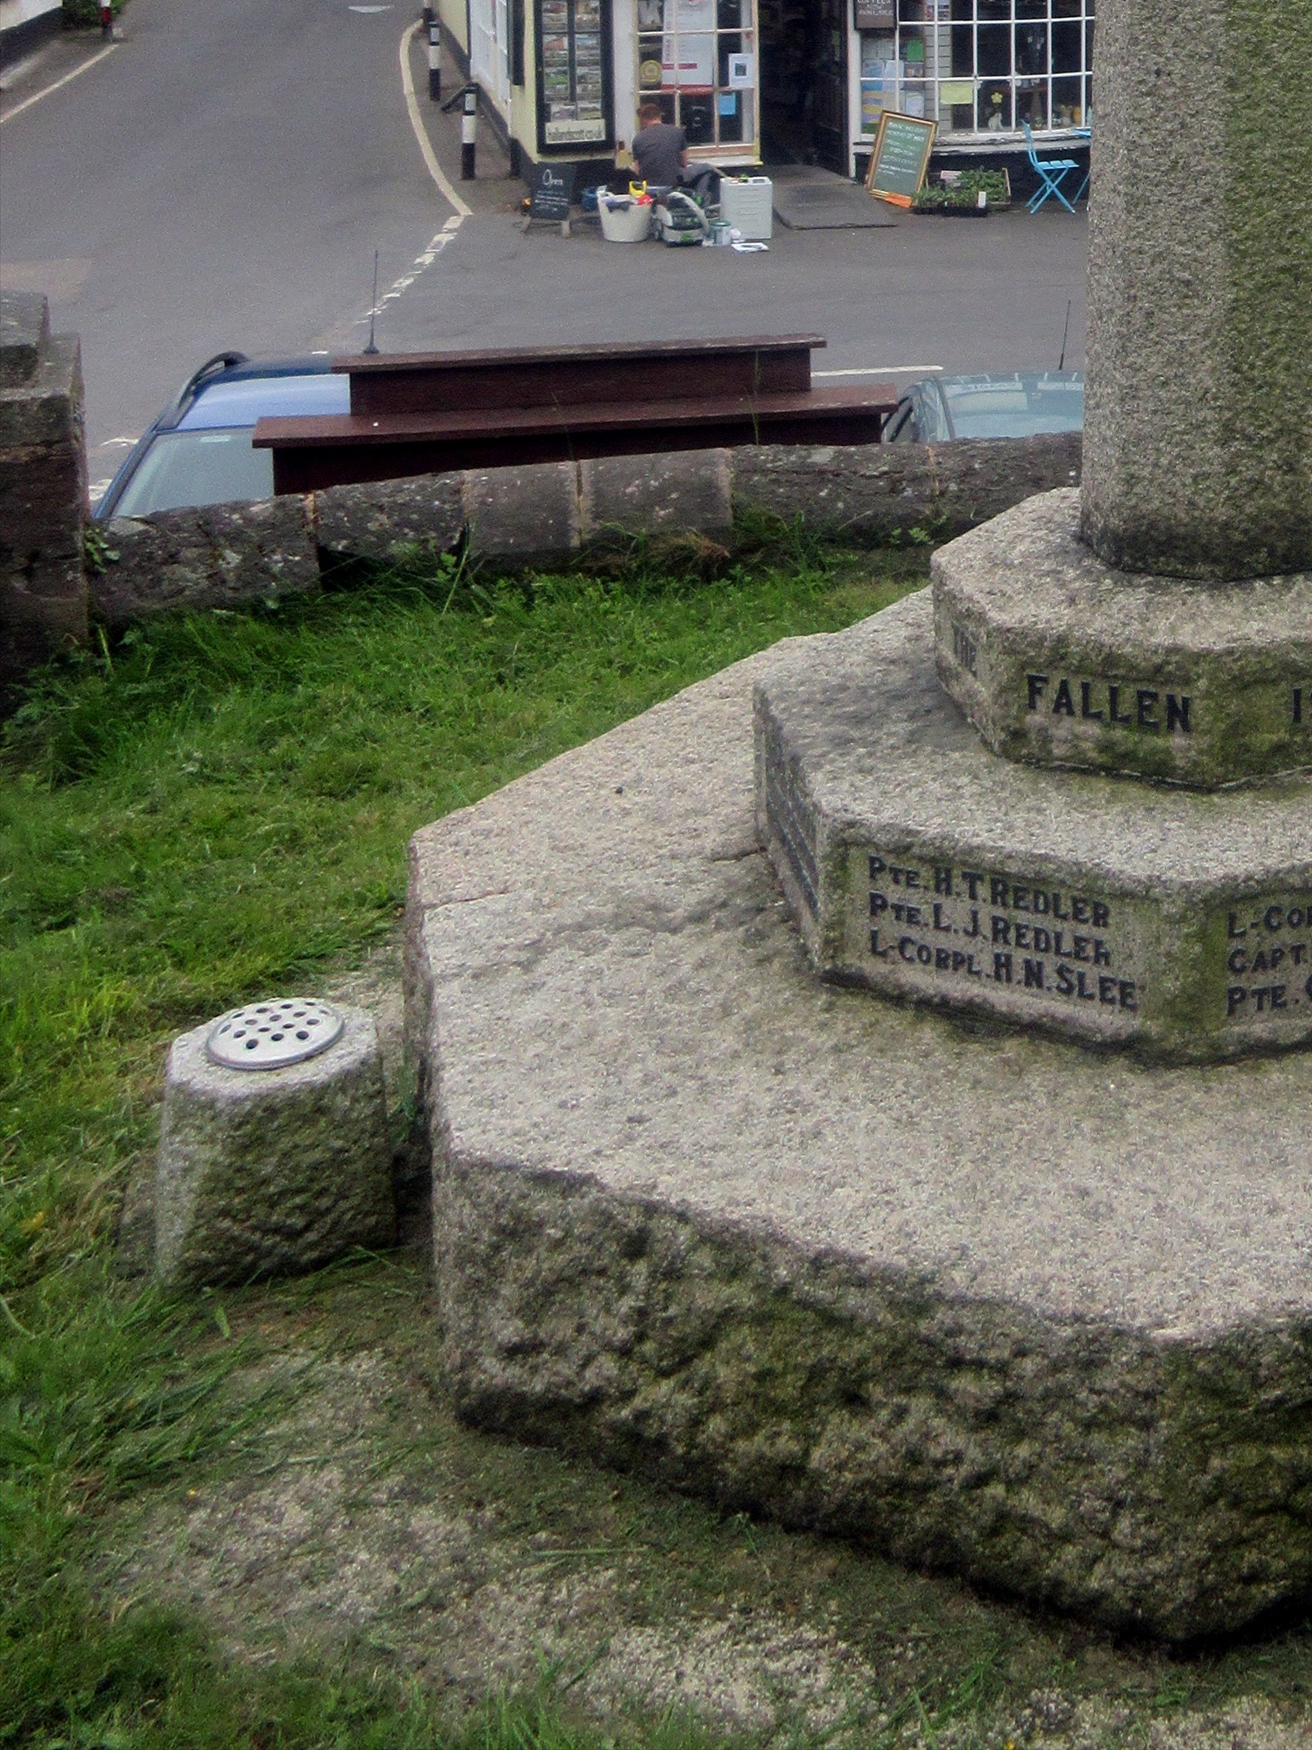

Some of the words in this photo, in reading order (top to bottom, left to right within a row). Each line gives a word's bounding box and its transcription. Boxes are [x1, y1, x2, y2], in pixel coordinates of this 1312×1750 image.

[1026, 673, 1193, 733] FALLEN
[989, 875, 1111, 928] REDLER
[1054, 962, 1139, 1013] SLEE
